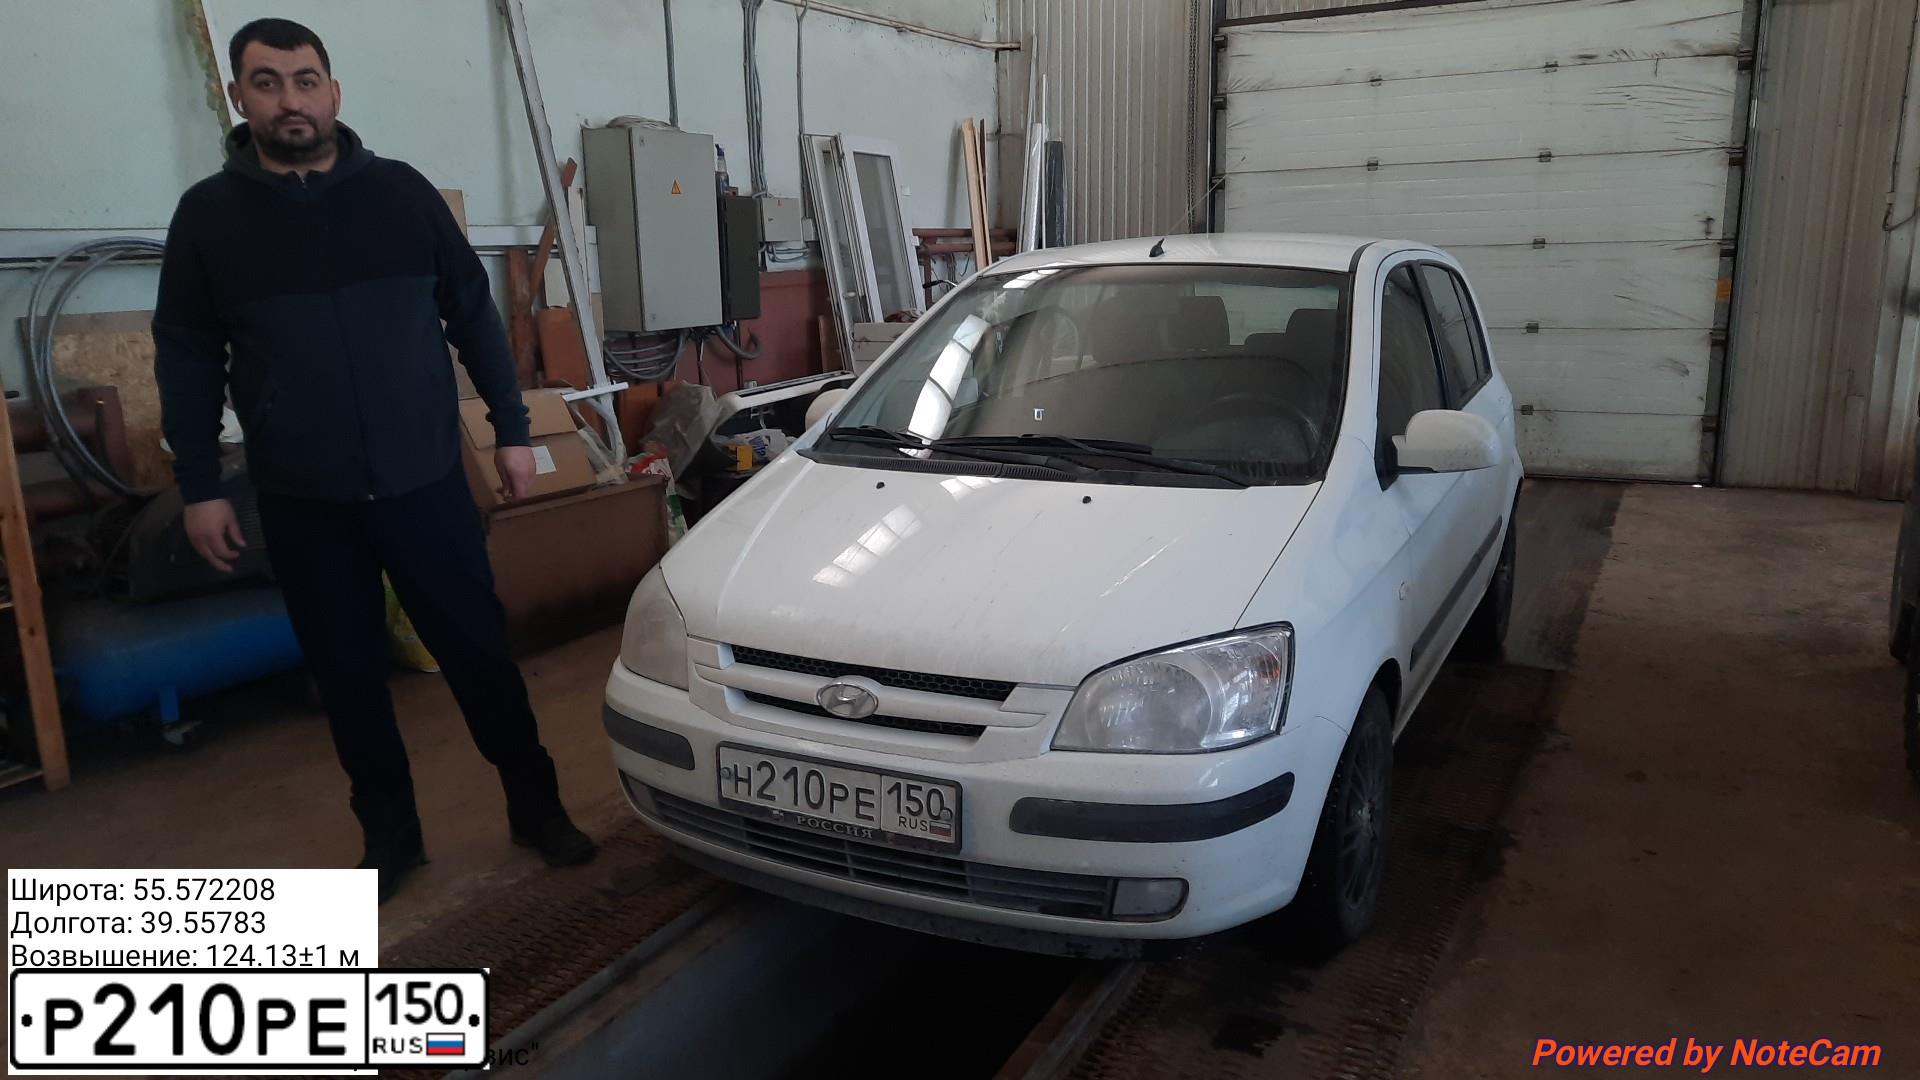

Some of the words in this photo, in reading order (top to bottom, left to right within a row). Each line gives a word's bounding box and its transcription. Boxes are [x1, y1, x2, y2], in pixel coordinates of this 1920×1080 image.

[733, 760, 875, 822] Н210РЕ
[887, 781, 945, 820] 150
[796, 815, 873, 839] РОССИЯ
[898, 815, 928, 832] RUS
